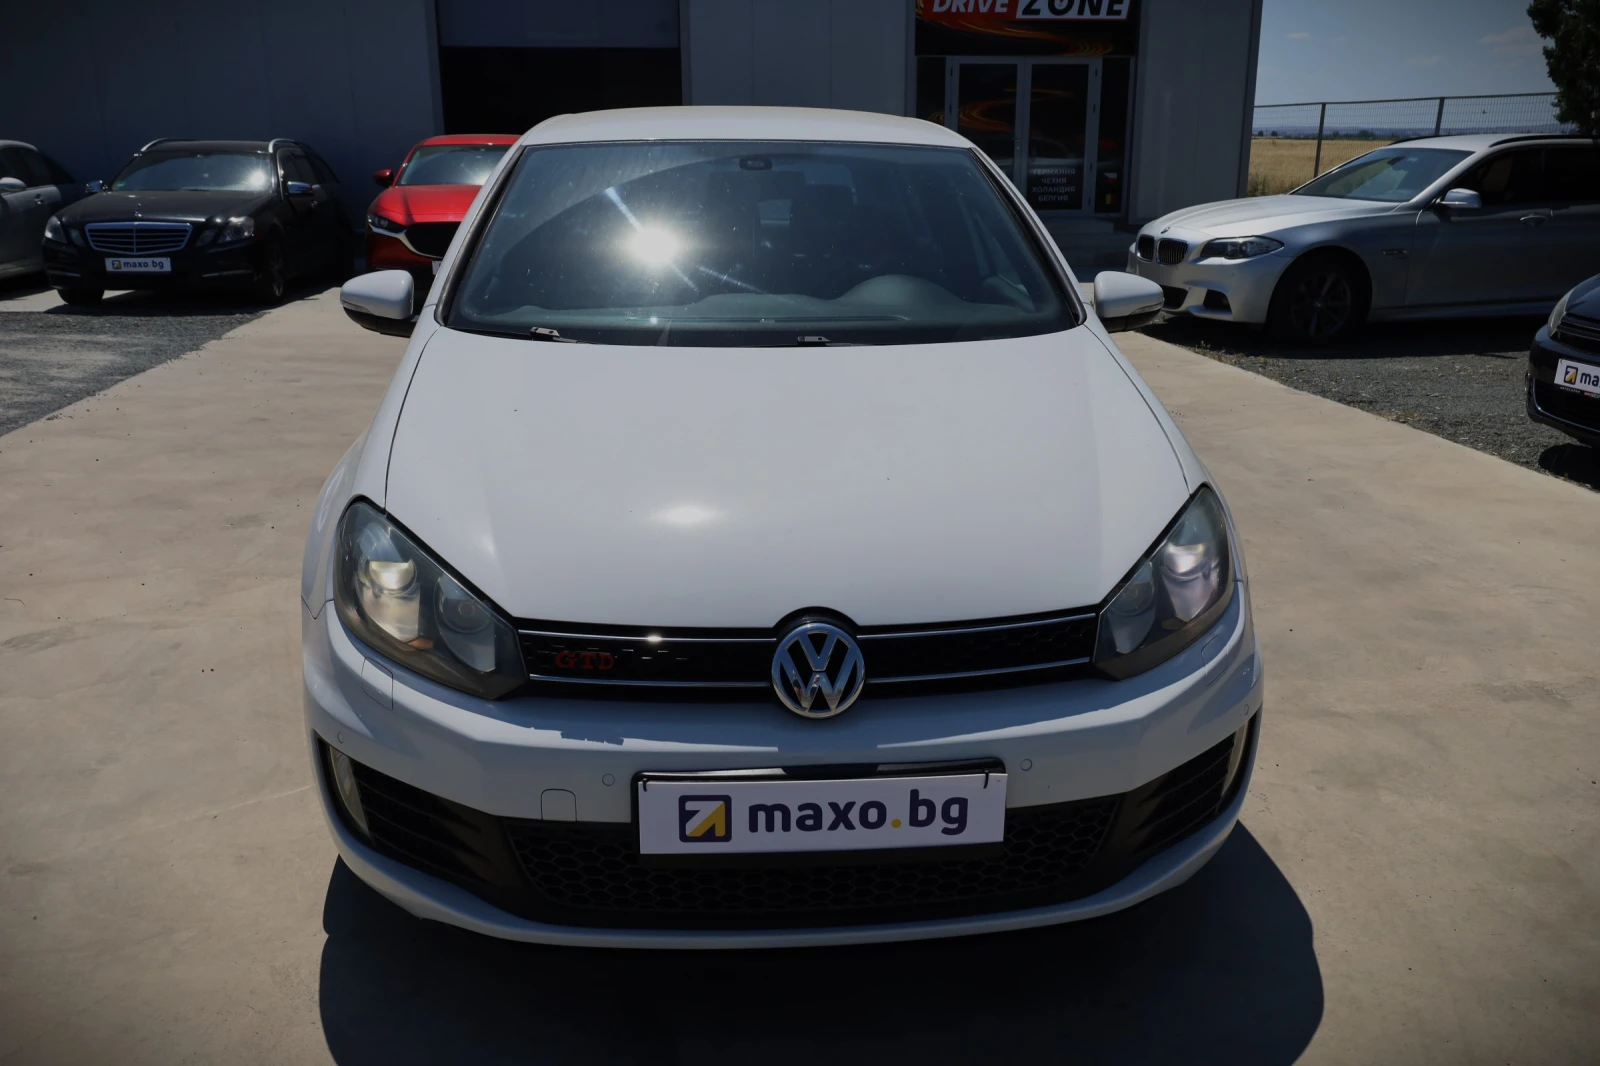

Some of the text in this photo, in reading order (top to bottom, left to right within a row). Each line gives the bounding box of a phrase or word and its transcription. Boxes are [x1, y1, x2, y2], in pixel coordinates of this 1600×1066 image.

[932, 0, 1125, 16] DRIVE ZONE
[1033, 168, 1076, 176] ГЕРМАНИЯ
[1041, 177, 1067, 185] ЧЕХИЯ
[1031, 186, 1076, 194] ХОЛАНДИЯ
[1038, 194, 1069, 203] БЕЛГИЯ
[123, 260, 164, 269] maxo.bg
[1580, 372, 1600, 388] ma
[555, 651, 615, 670] GTD
[748, 788, 969, 836] maxo.bg
